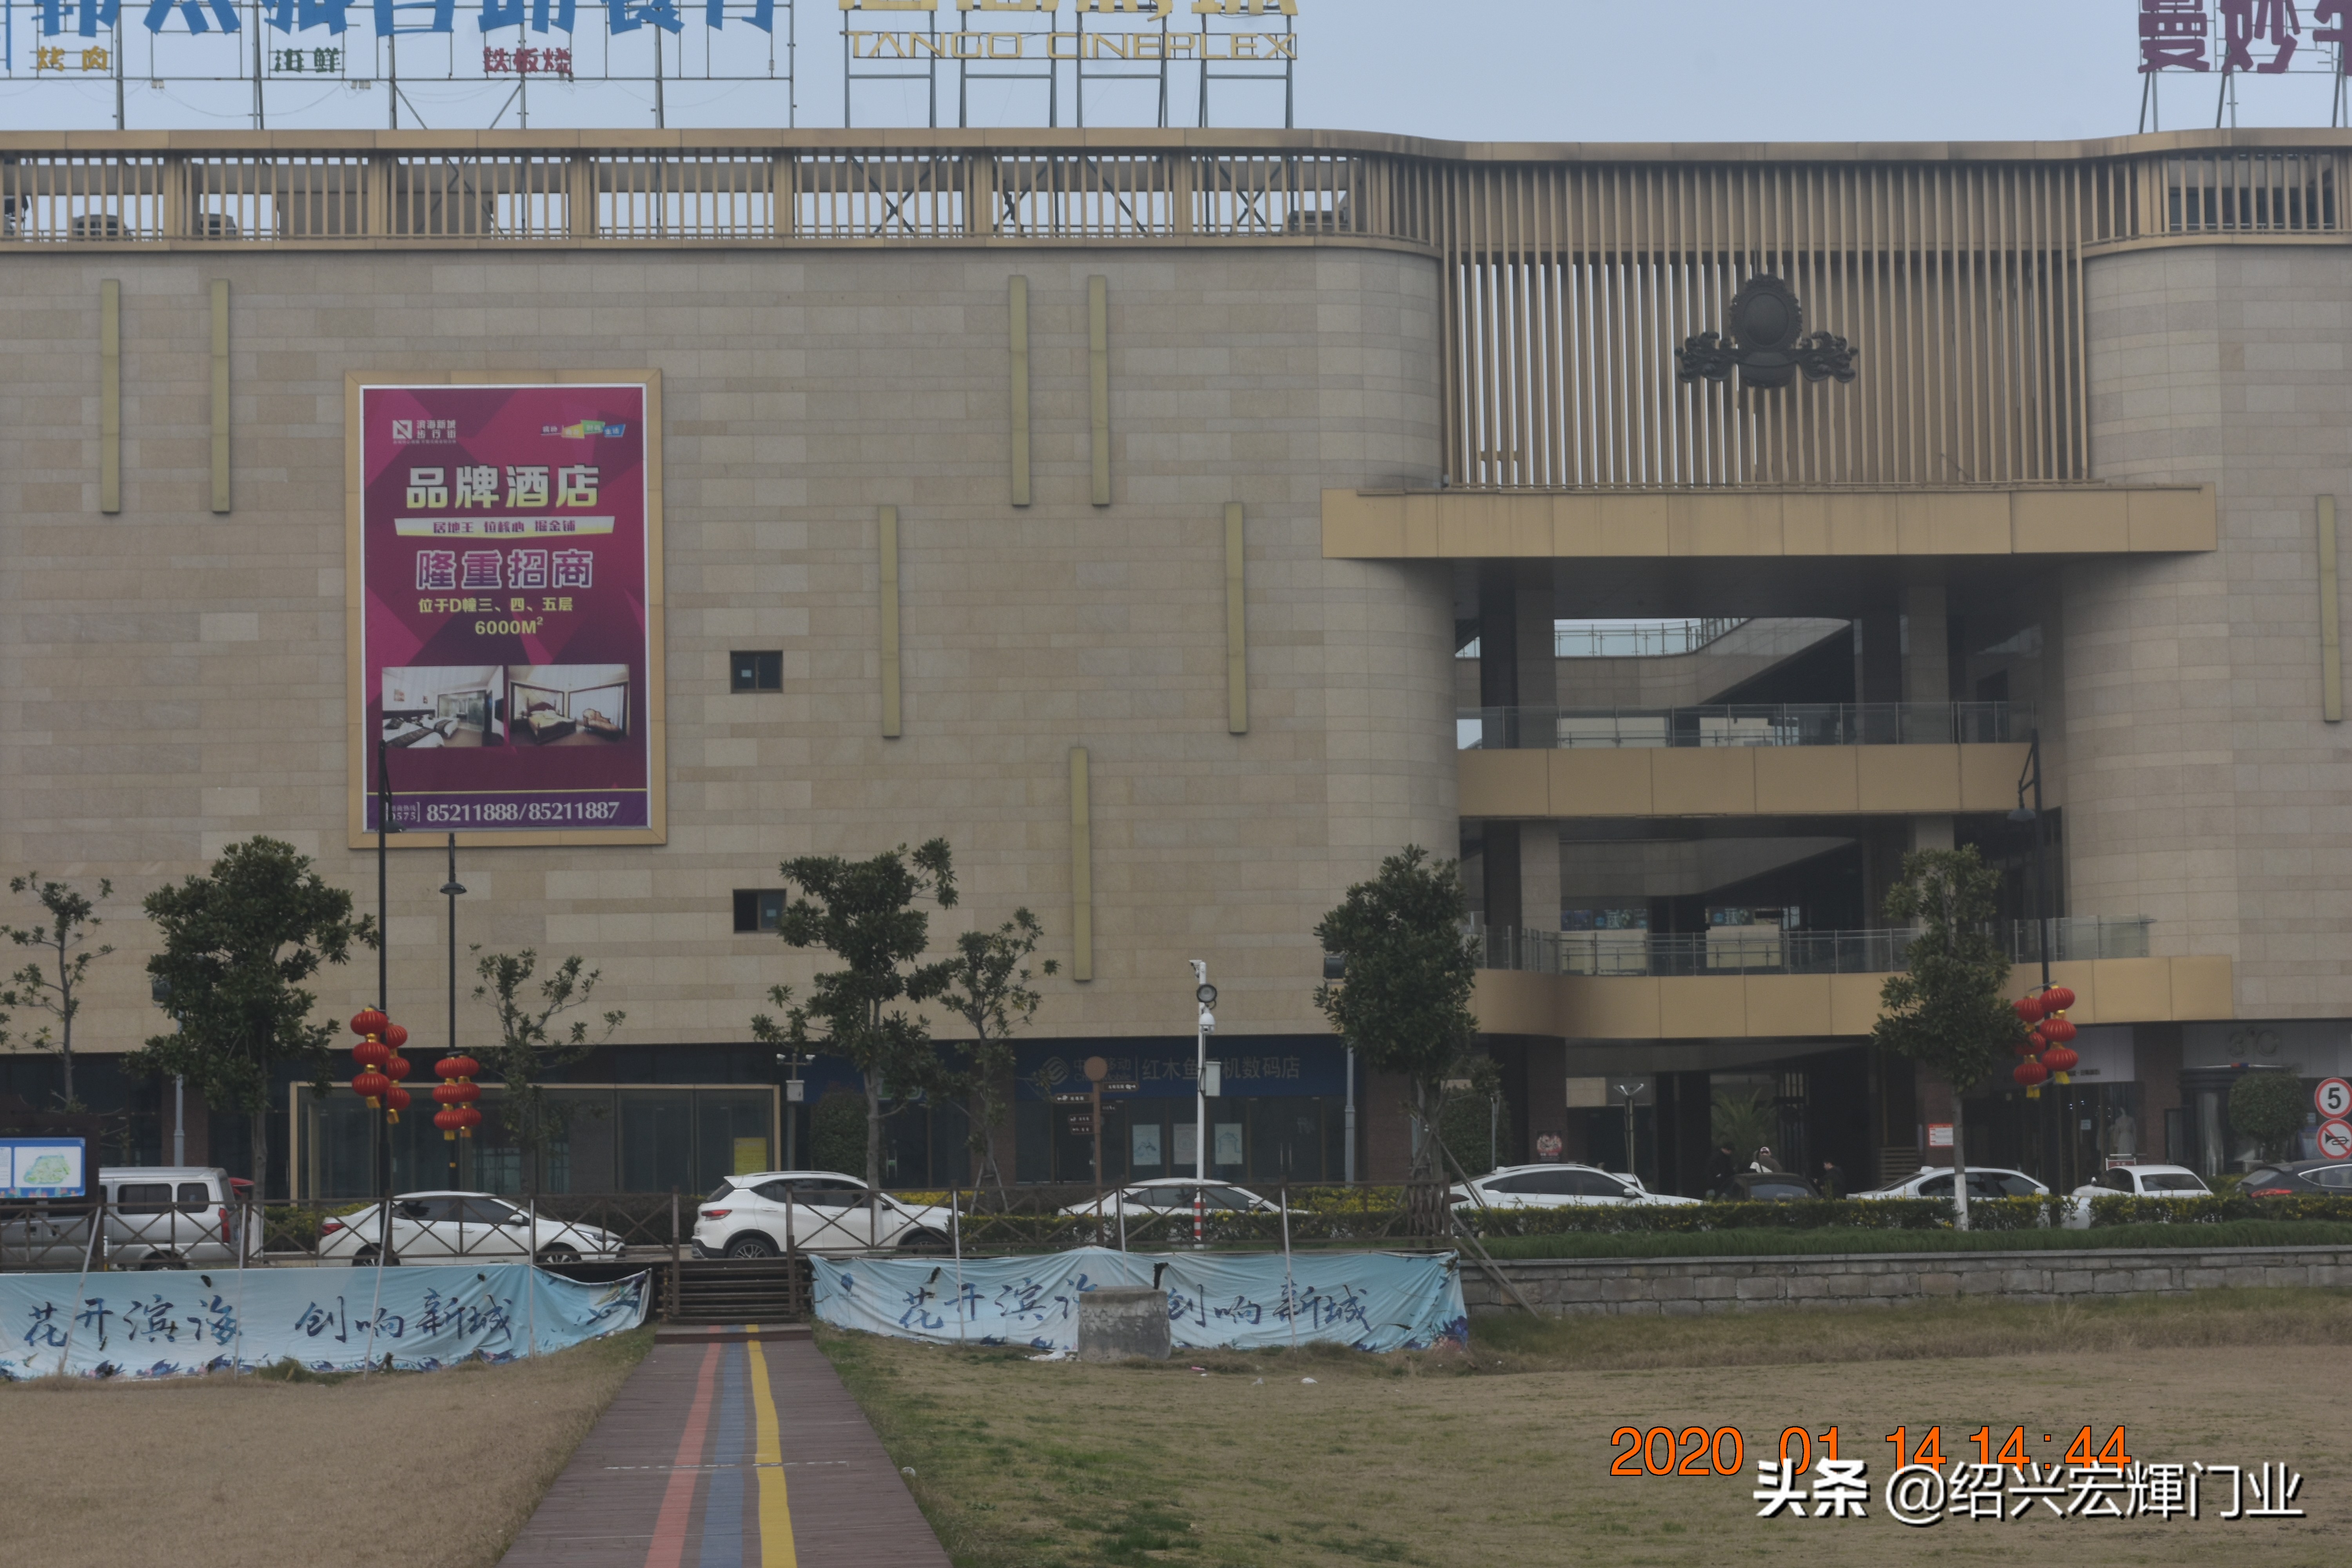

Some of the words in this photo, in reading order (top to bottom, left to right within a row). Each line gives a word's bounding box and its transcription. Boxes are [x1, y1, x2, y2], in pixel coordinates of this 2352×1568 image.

[845, 31, 1021, 59] TANGO
[1046, 31, 1298, 60] CINEPLEX
[37, 45, 108, 72] 烤肉
[274, 47, 340, 73] 海鲜
[483, 46, 572, 73] 铁板烧
[417, 429, 456, 439] 步行街
[406, 464, 599, 509] 品牌酒店
[433, 522, 474, 534] 居地王
[416, 549, 593, 590] 隆重招商
[426, 802, 620, 822] 85211888/85211887
[1074, 1057, 1131, 1073] 中移动
[1142, 1055, 1300, 1080] 红木鱼机数码店
[2327, 1087, 2341, 1109] 5
[24, 1294, 242, 1347] 花开滨海
